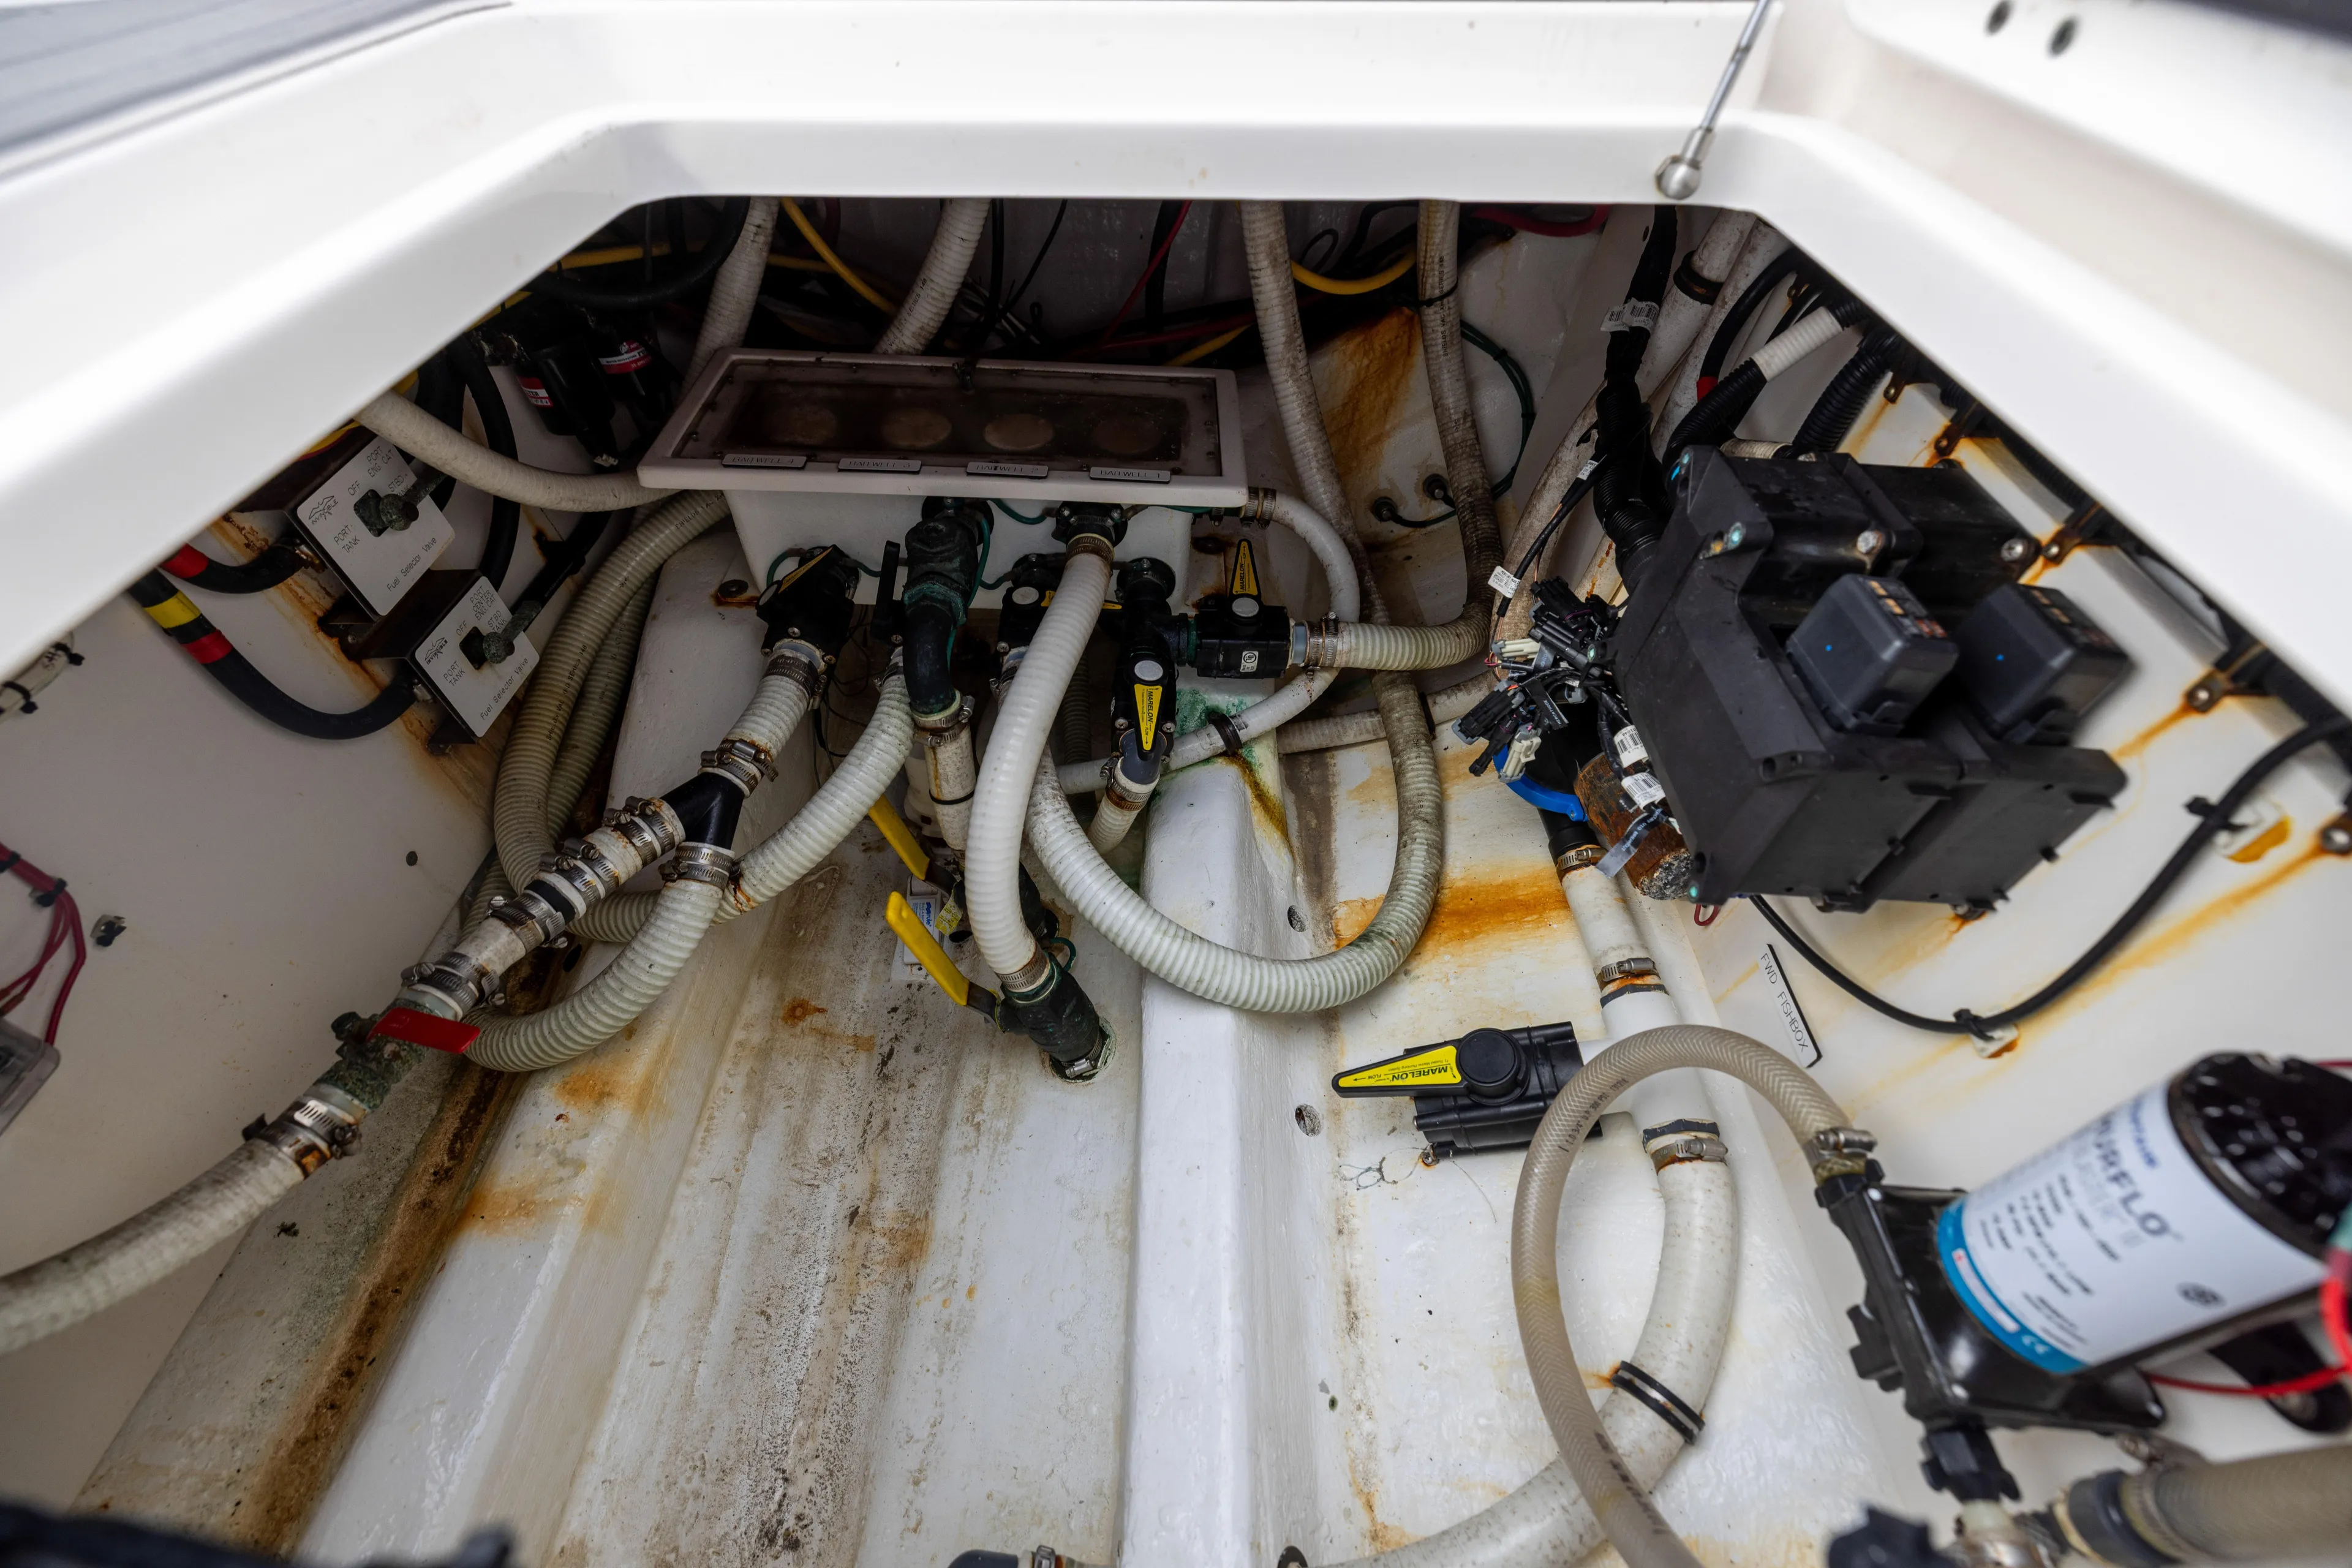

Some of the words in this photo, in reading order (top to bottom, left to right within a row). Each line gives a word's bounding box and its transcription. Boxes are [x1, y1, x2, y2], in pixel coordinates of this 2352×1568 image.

[367, 446, 383, 464] PORT
[368, 463, 382, 477] ENG
[382, 450, 394, 464] CAT
[348, 480, 360, 496] OFF
[388, 475, 404, 492] STBD
[311, 499, 338, 525] INVINCIBLE
[333, 524, 352, 545] PORT
[342, 537, 360, 554] TANK
[386, 576, 401, 592] Fuel
[401, 554, 421, 577] Selector
[422, 537, 437, 552] Valve
[1500, 570, 1511, 579] MERCURY
[470, 586, 486, 604] PORT
[473, 590, 492, 612] CENTER
[486, 594, 496, 608] CAT
[487, 610, 502, 627] STBD
[456, 620, 467, 636] OFF
[426, 639, 448, 665] INVINCIBLE
[443, 660, 459, 681] PORT
[449, 669, 466, 687] TANK
[480, 704, 493, 720] Fuel
[493, 677, 514, 703] Selector
[514, 657, 528, 675] Valve
[1543, 699, 1562, 726] MERCATHODE
[1761, 953, 1777, 984] FWD
[1777, 992, 1809, 1052] FISHBOX
[1391, 1065, 1448, 1081] MARELON
